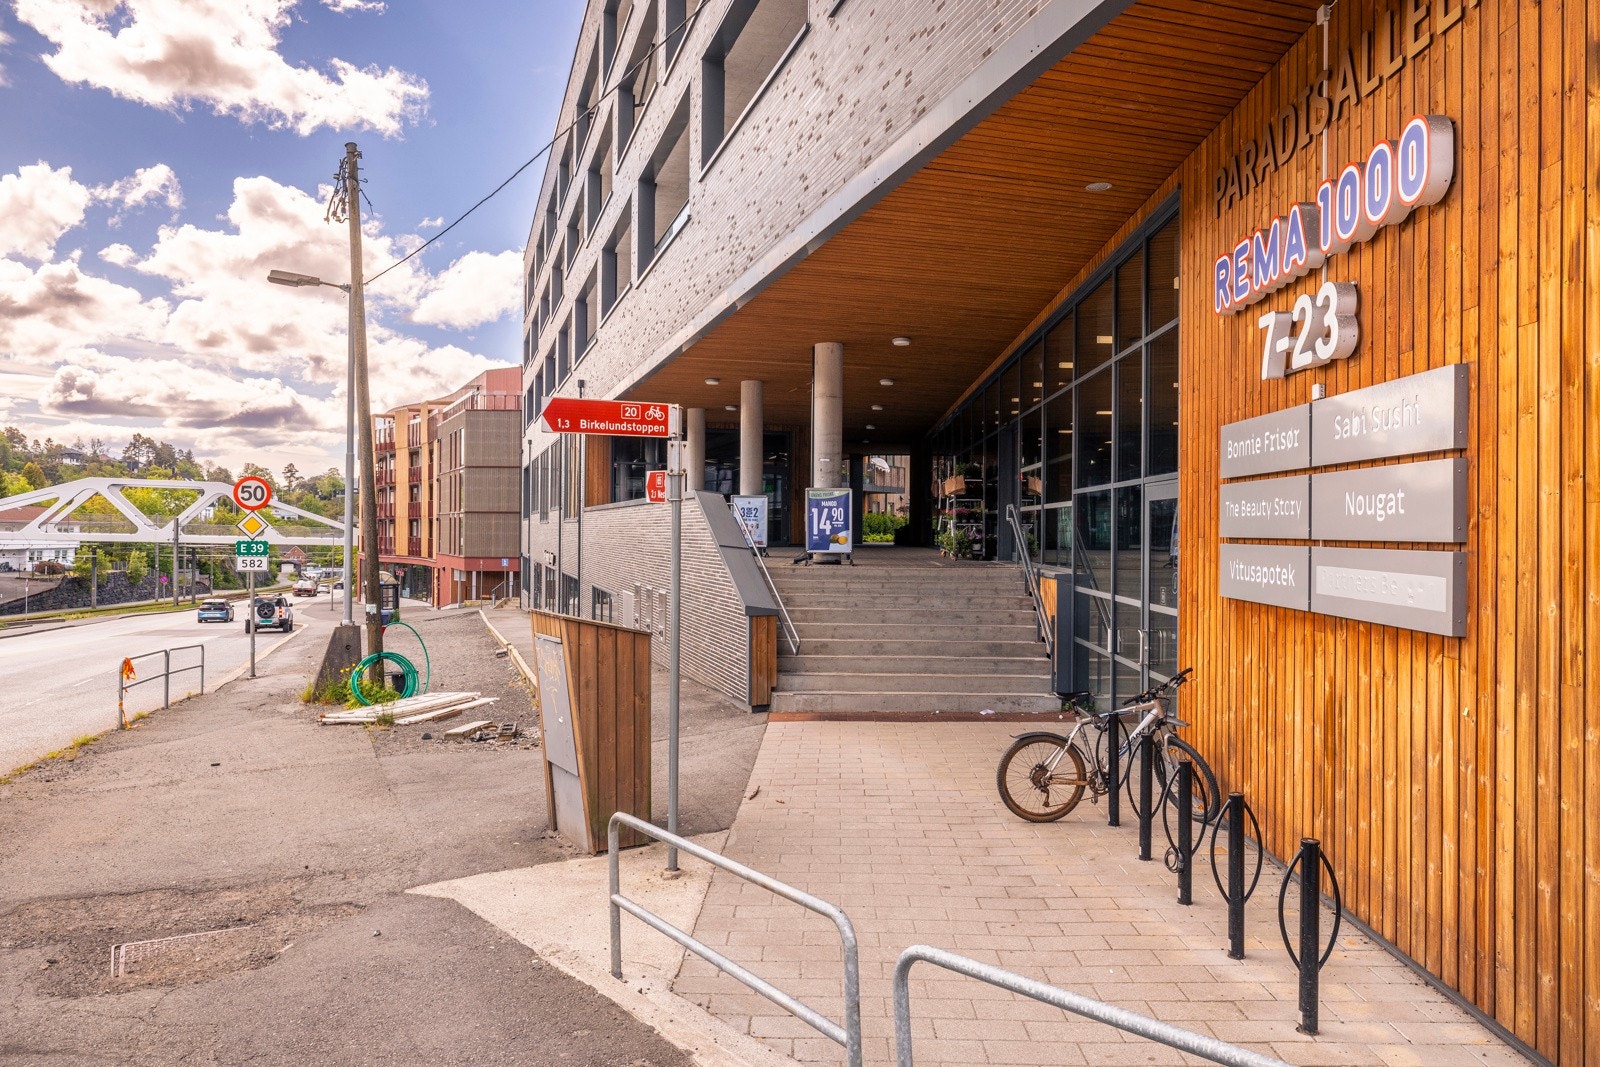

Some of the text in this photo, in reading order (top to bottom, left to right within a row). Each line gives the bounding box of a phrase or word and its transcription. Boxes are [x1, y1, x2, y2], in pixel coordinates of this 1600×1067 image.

[1215, 114, 1431, 314] REMA 1000
[1258, 282, 1339, 380] 7-23
[624, 407, 637, 417] 20
[1334, 395, 1421, 440] Sabi Sushi
[580, 419, 665, 434] Birkelundstoppen
[1227, 428, 1300, 459] Bonnie Frisør
[240, 485, 265, 502] 50
[1345, 488, 1405, 522] Nougat
[753, 507, 759, 518] 2
[811, 507, 844, 535] 14 90
[1225, 498, 1302, 520] The Beauty Story
[240, 543, 265, 553] E 39
[241, 559, 263, 568] 582
[1229, 559, 1296, 588] Vitusapotek
